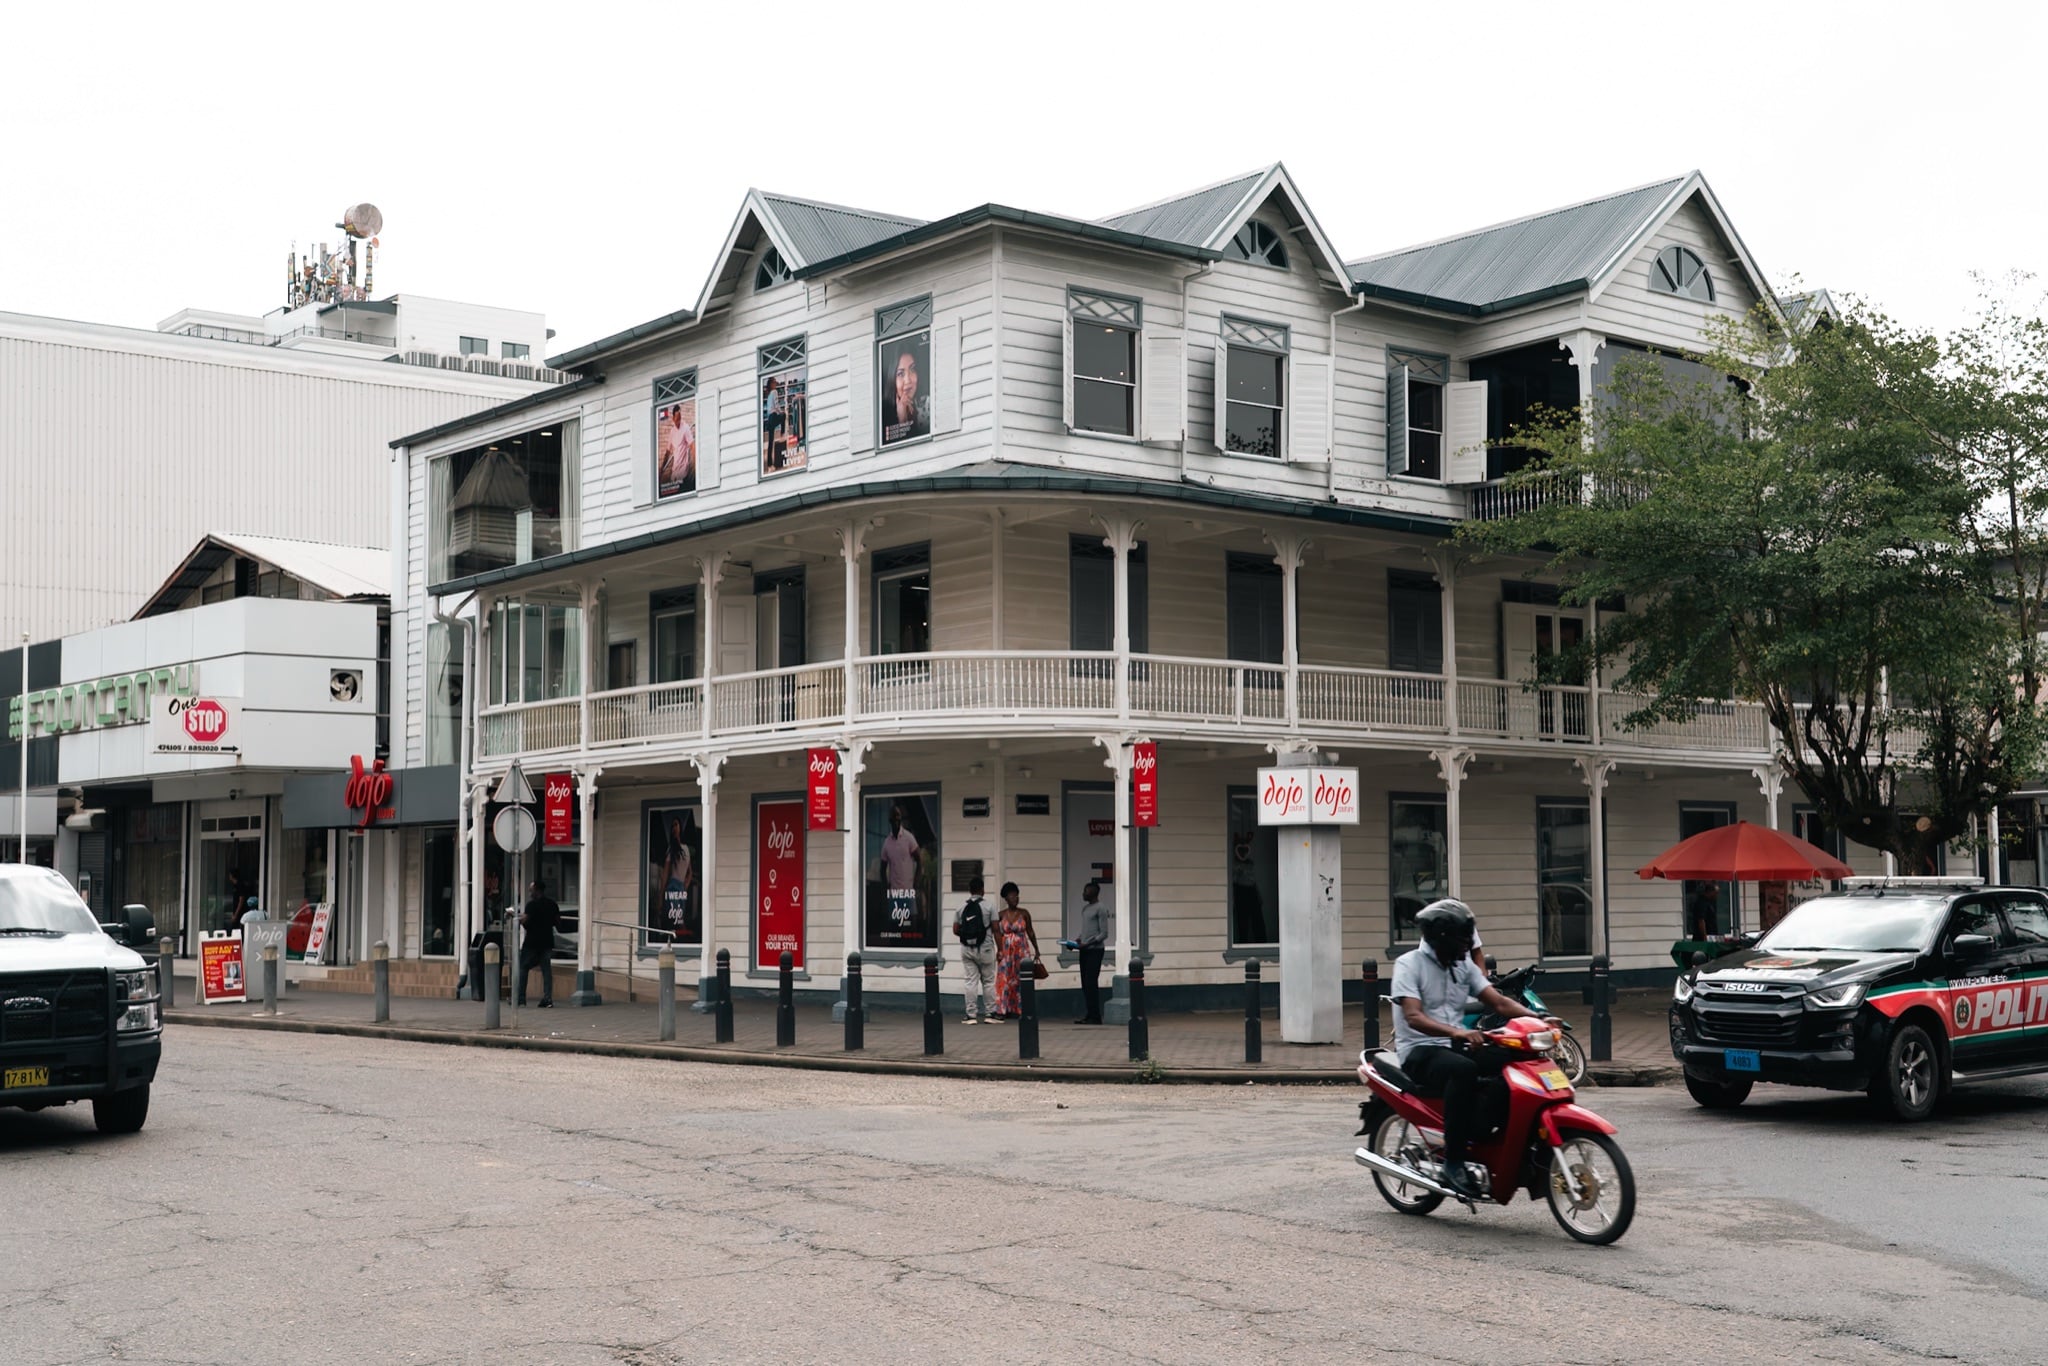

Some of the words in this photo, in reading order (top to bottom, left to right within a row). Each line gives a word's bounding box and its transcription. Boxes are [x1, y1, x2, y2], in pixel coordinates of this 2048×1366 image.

[168, 696, 198, 716] One
[188, 709, 223, 733] STOP
[810, 753, 834, 779] dojo
[1135, 751, 1155, 776] dojo
[345, 754, 393, 827] dojo
[547, 781, 570, 803] dojo
[1264, 774, 1303, 816] dojo
[1314, 773, 1351, 816] dojo
[768, 820, 794, 859] dojo
[665, 891, 668, 900] I
[668, 891, 688, 900] WEAR
[887, 889, 890, 899] I
[891, 888, 916, 899] WEAR
[668, 902, 683, 925] dojo
[891, 901, 911, 927] dojo
[253, 925, 283, 946] dojo
[765, 942, 782, 950] YOUR
[782, 942, 798, 951] STYLE
[767, 934, 778, 942] OUR
[778, 934, 796, 942] BRANDS
[1724, 983, 1765, 992] ISUZU
